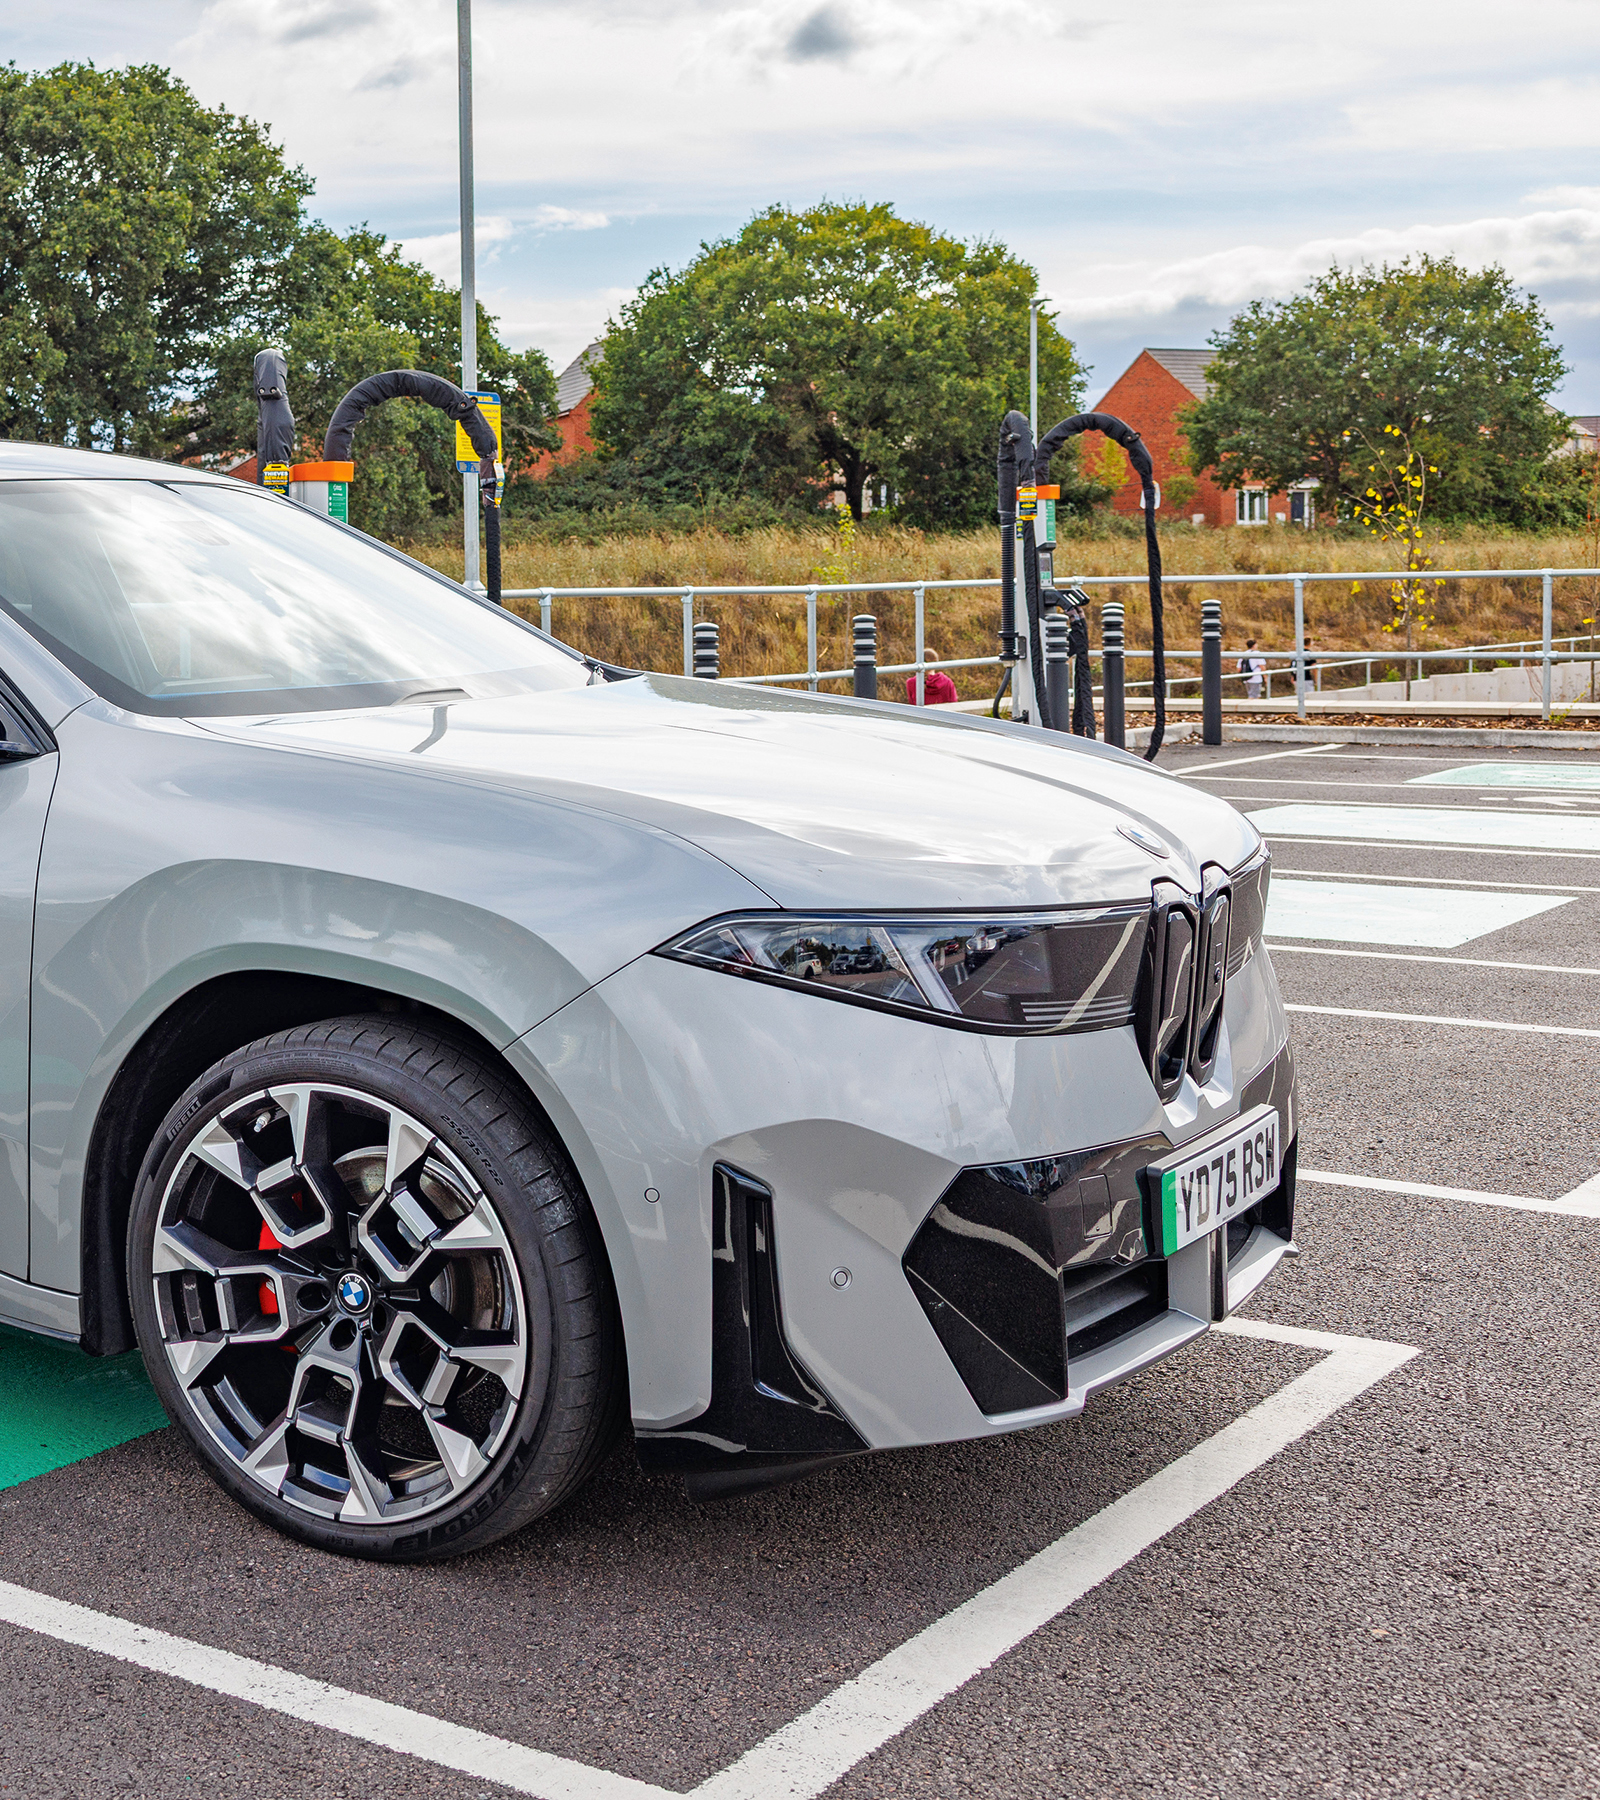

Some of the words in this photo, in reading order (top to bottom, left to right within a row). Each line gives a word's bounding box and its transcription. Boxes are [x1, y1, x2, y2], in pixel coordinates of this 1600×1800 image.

[165, 1096, 202, 1142] PIRELLI
[440, 1114, 483, 1156] 255/35
[481, 1158, 504, 1187] R22
[1180, 1148, 1238, 1233] YD75
[1242, 1123, 1275, 1199] RSW
[338, 1276, 362, 1291] BMW
